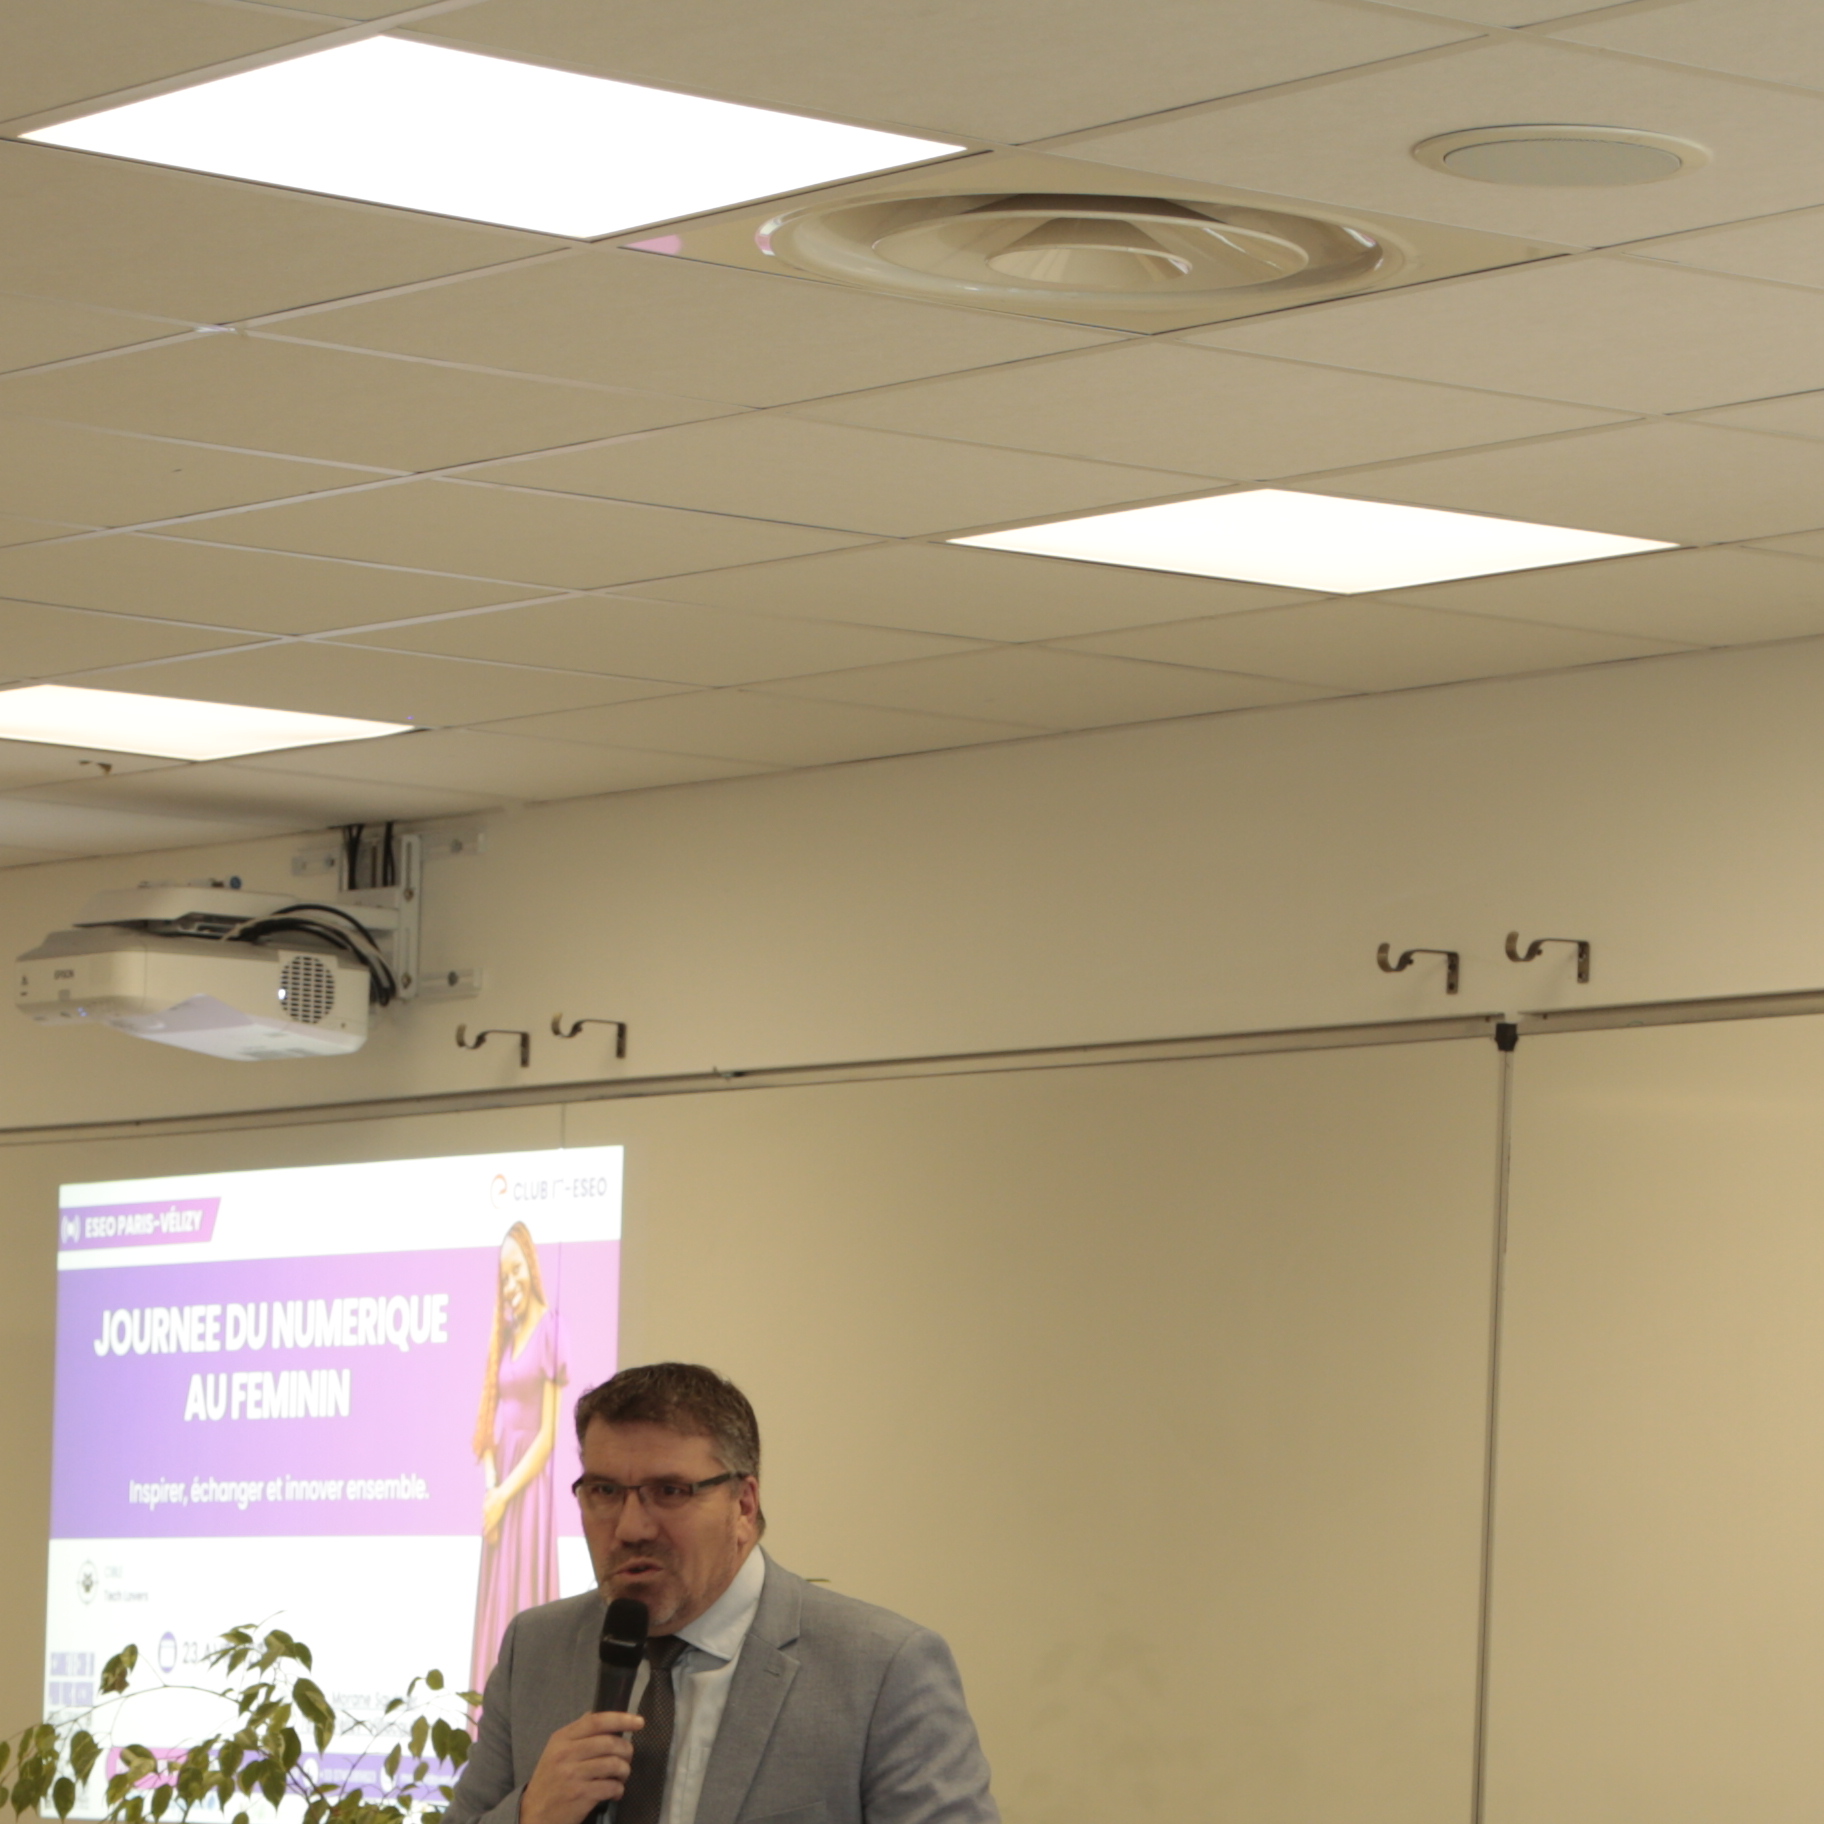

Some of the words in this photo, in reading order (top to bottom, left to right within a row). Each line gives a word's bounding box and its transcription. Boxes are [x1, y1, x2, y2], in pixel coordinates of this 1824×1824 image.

[514, 1181, 548, 1201] CLUB
[85, 1216, 116, 1238] ESEO
[117, 1205, 204, 1237] PARIS-VÉLIZY
[93, 1304, 222, 1357] JOURNEE
[226, 1302, 268, 1351] DU
[271, 1293, 449, 1353] NUMERIQUE
[184, 1373, 227, 1421] AU
[231, 1368, 351, 1420] FEMININ
[129, 1477, 188, 1511] Inspirer,
[190, 1476, 264, 1511] échanger
[266, 1477, 283, 1501] et
[285, 1474, 345, 1501] innover
[346, 1473, 430, 1500] ensemble.
